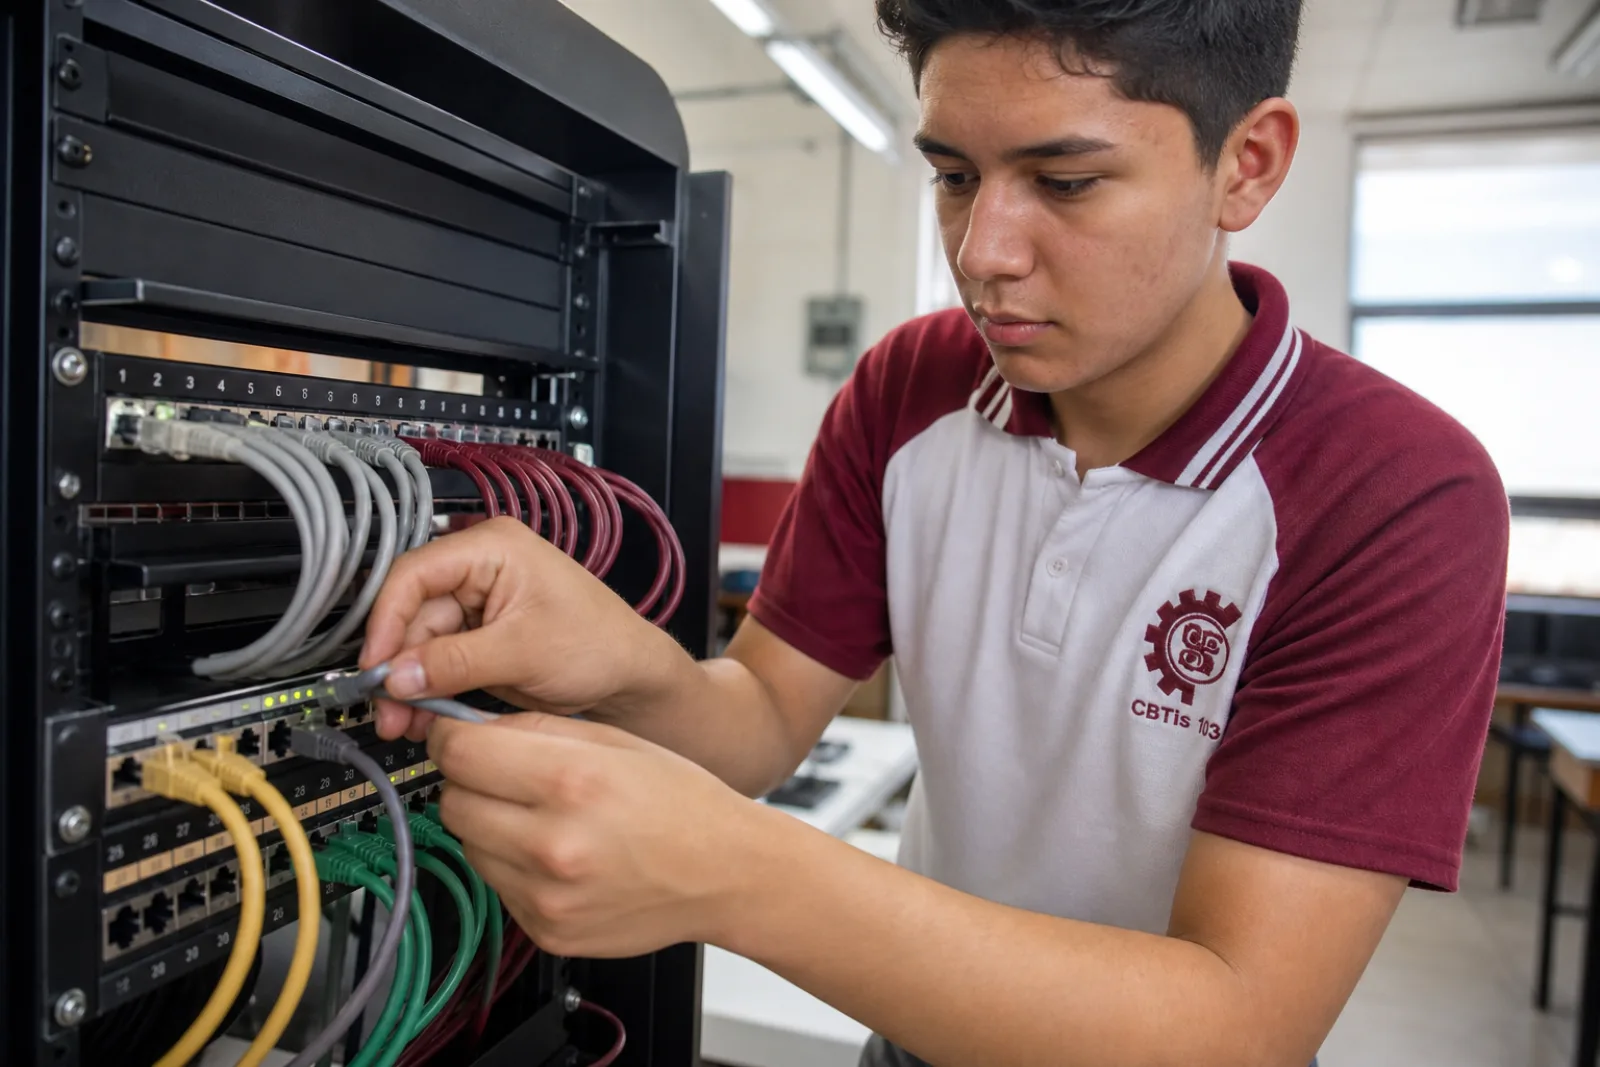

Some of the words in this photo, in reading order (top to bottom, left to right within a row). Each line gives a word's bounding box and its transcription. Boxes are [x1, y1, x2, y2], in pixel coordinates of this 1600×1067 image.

[118, 369, 126, 383] 1
[153, 373, 162, 387] 2
[186, 376, 195, 389] 3
[217, 379, 225, 392] 4
[247, 382, 254, 395] 5
[275, 385, 282, 397] 6
[1131, 699, 1191, 728] CBTis
[1198, 717, 1221, 740] 103
